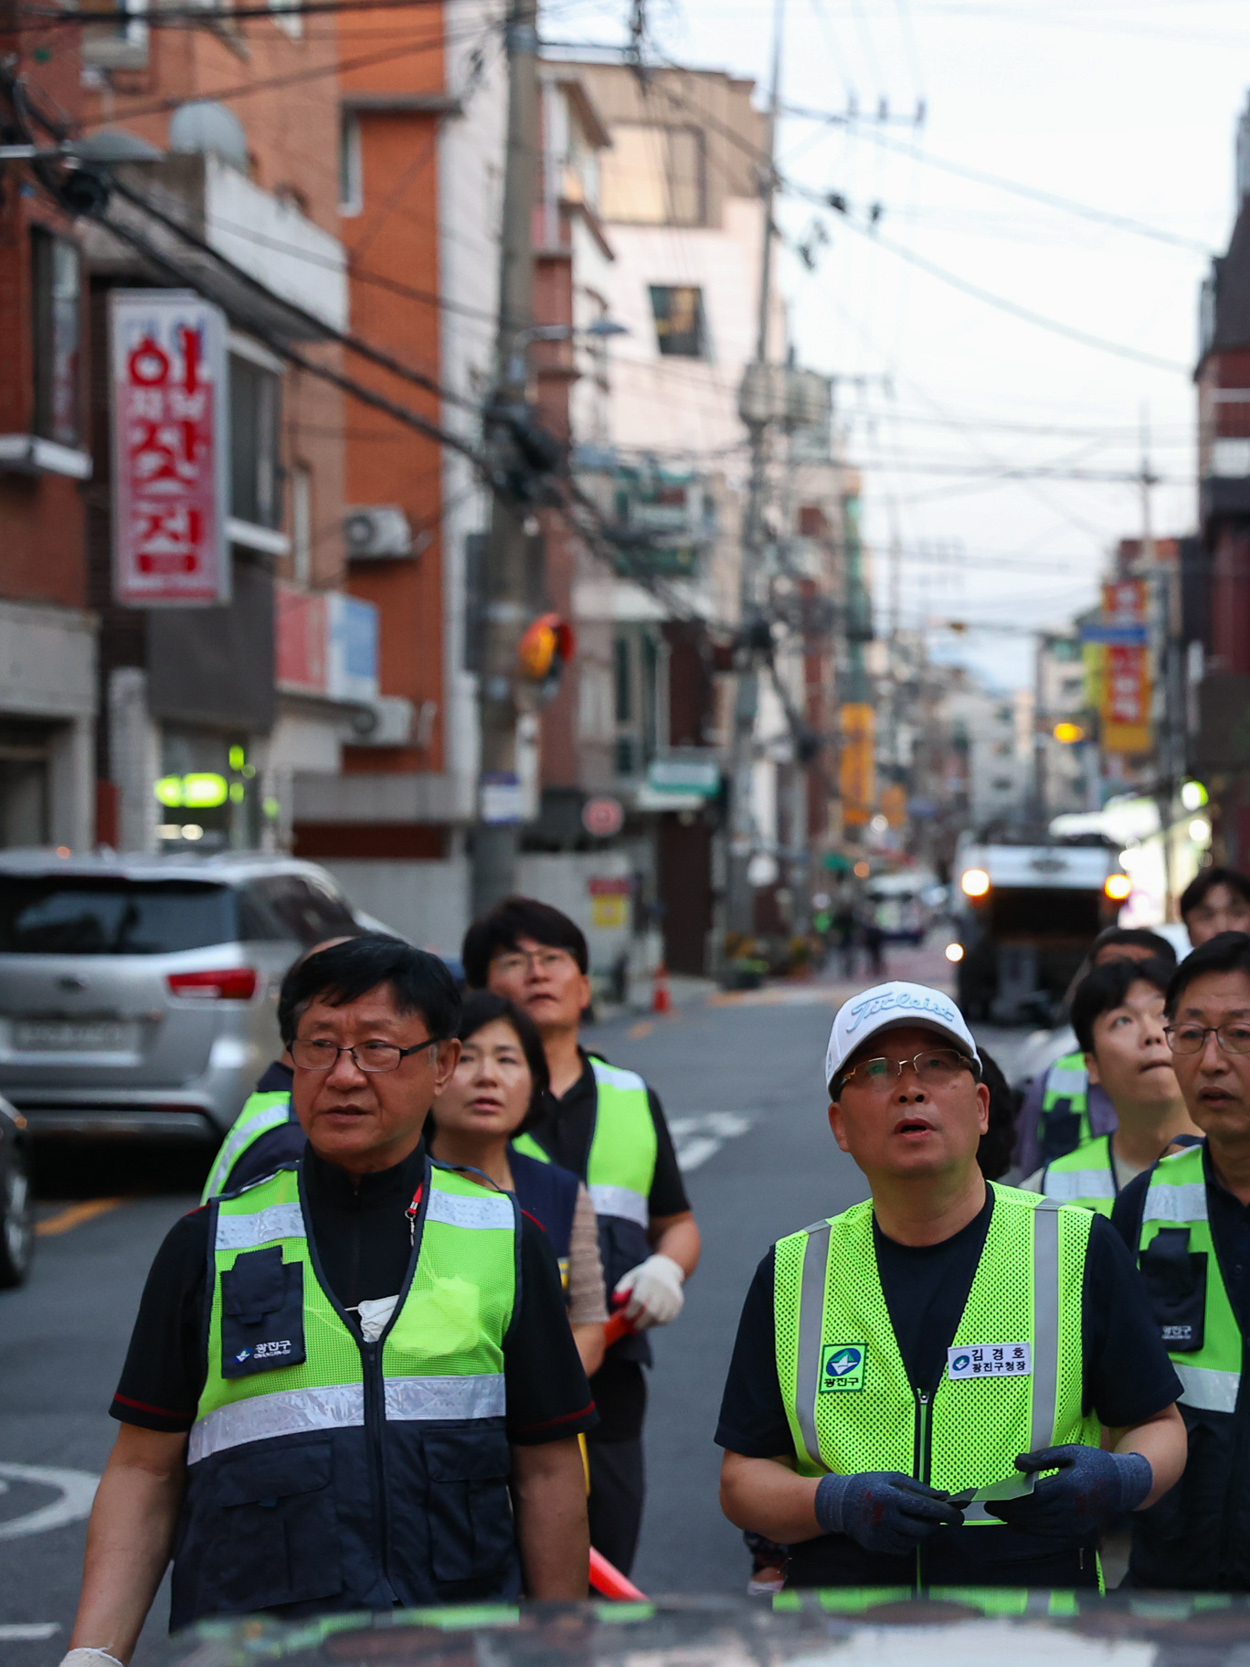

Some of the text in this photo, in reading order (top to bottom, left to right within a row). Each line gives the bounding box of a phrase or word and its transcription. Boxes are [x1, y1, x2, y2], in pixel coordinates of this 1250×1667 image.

[846, 992, 955, 1033] Titleist
[972, 1360, 1027, 1373] 광진구청장
[824, 1377, 860, 1388] 광진구
